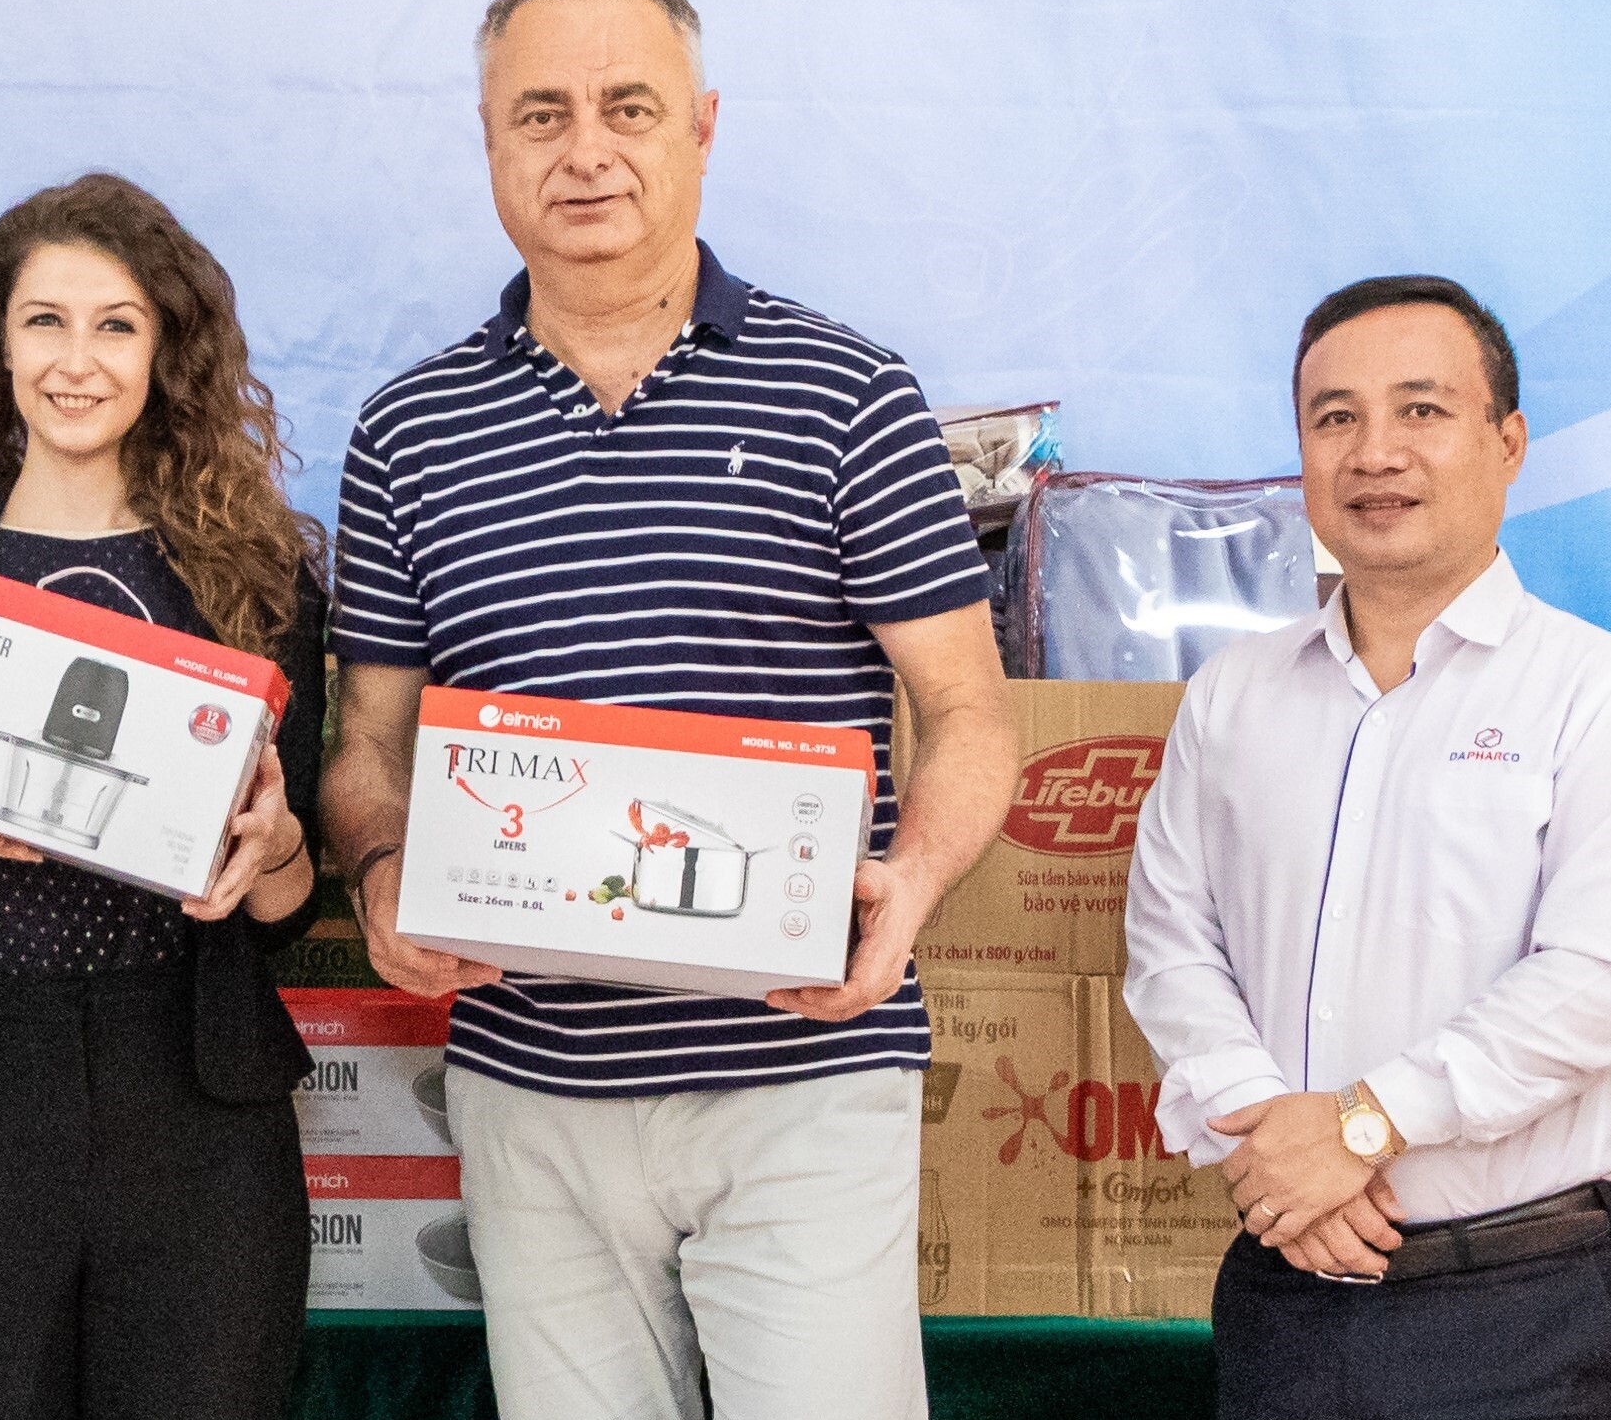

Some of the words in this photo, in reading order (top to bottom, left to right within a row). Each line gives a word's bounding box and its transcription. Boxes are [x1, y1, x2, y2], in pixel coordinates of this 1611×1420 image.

[206, 710, 219, 724] 12
[503, 711, 561, 731] elmich
[741, 737, 775, 749] MODEL
[444, 744, 498, 779] TRI
[509, 751, 590, 784] MAX
[1449, 751, 1520, 762] DAPHARCO
[500, 803, 524, 838] 3
[494, 839, 527, 852] LAYERS
[458, 893, 482, 904] Size:
[485, 895, 513, 907] 26cm
[945, 944, 972, 960] chai
[986, 946, 1010, 960] 800
[1102, 1171, 1196, 1214] Comfort
